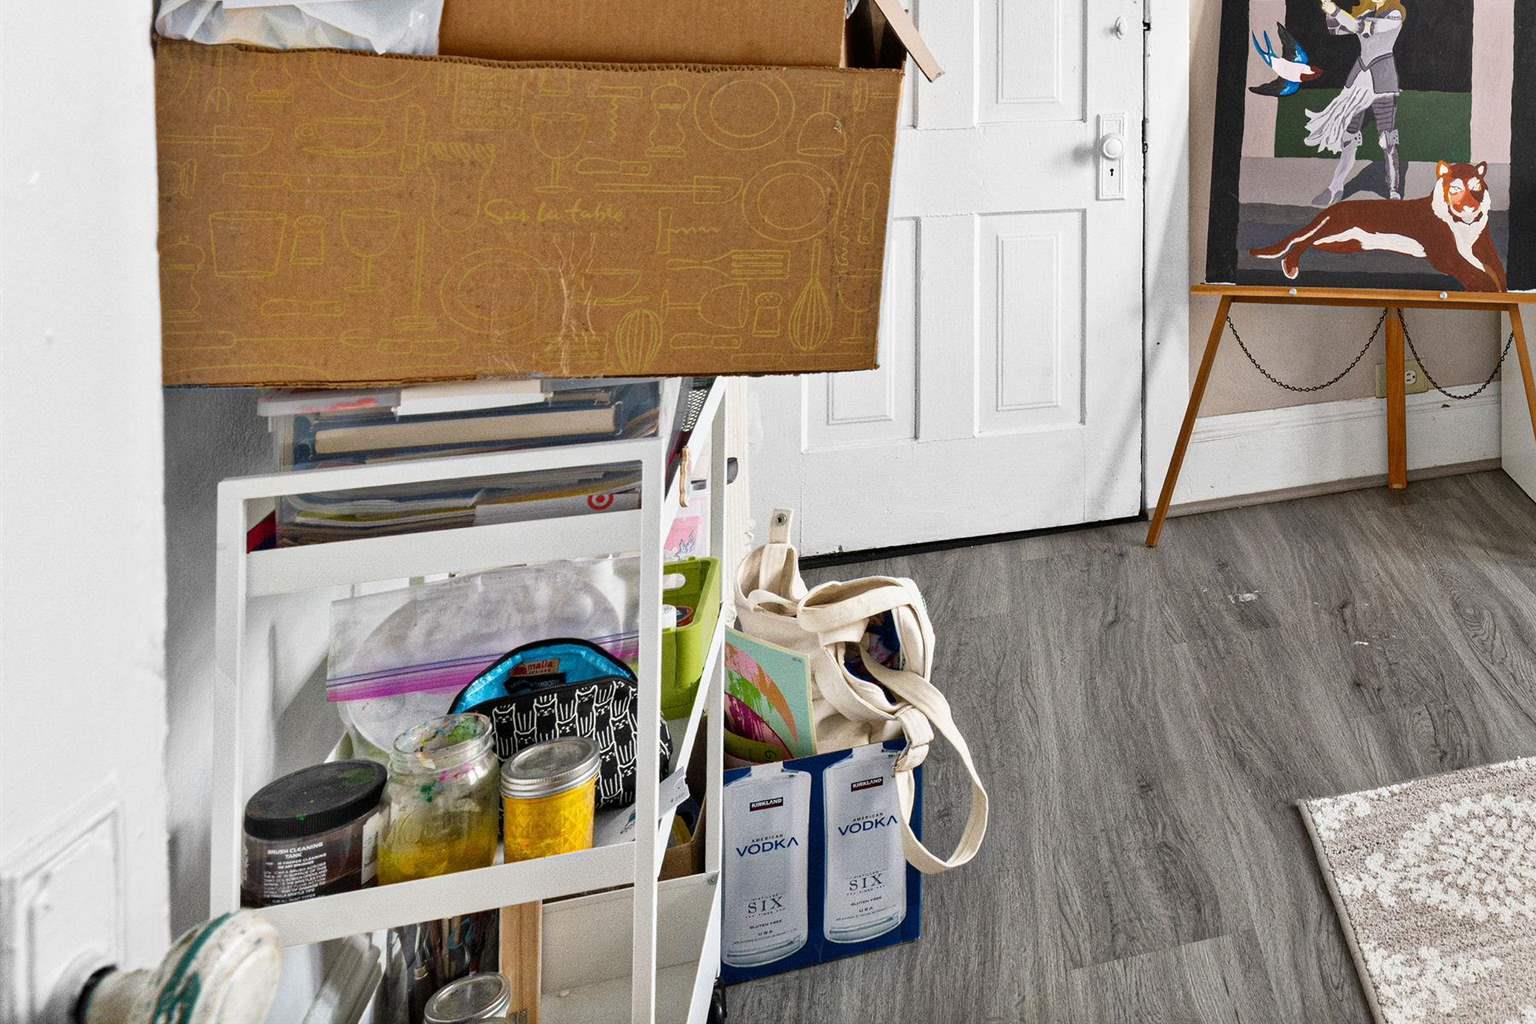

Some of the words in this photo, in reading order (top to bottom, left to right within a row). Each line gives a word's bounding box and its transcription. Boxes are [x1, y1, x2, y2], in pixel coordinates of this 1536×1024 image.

[484, 198, 529, 224] Sur
[565, 198, 624, 225] table
[853, 778, 883, 788] KIRKLAND
[751, 798, 783, 809] KIRKLAND
[838, 815, 898, 836] VODKA
[267, 848, 289, 856] BRUSH
[289, 841, 324, 854] CLEANING
[736, 836, 799, 857] VODKA
[850, 873, 882, 891] SIX
[748, 895, 783, 914] SIX
